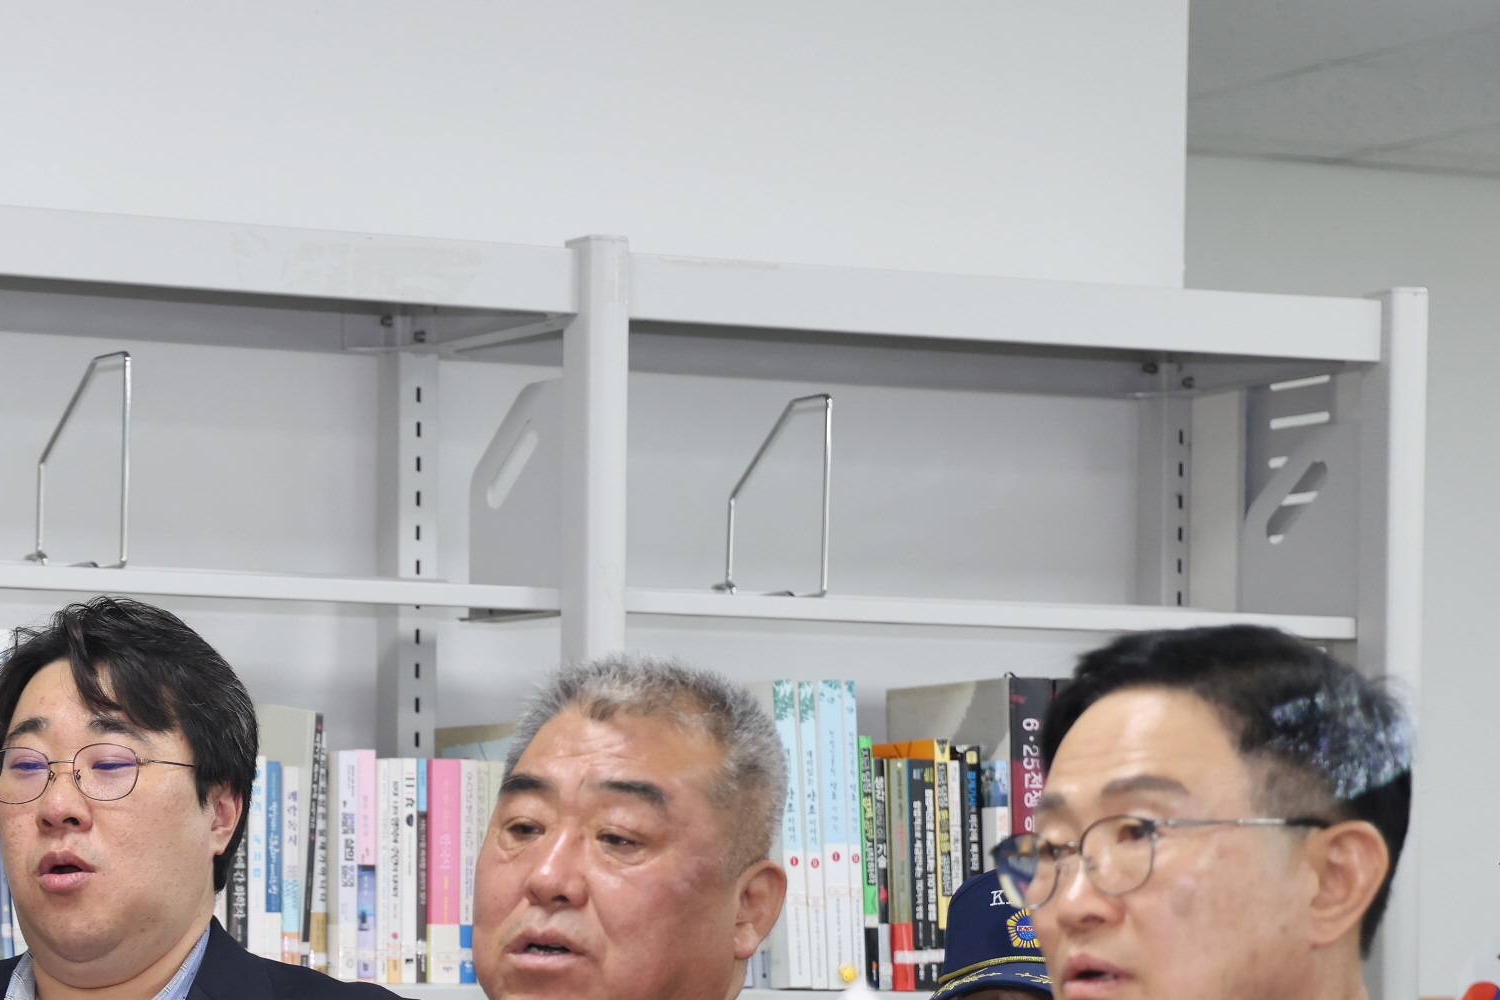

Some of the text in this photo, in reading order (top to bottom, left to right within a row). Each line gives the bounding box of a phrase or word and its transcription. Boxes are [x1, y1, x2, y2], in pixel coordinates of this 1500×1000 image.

[1020, 716, 1044, 809] 6·25전쟁
[968, 814, 979, 841] 바다에
[969, 842, 980, 872] 빠져라
[926, 873, 937, 902] 110가지
[927, 903, 937, 922] 방법
